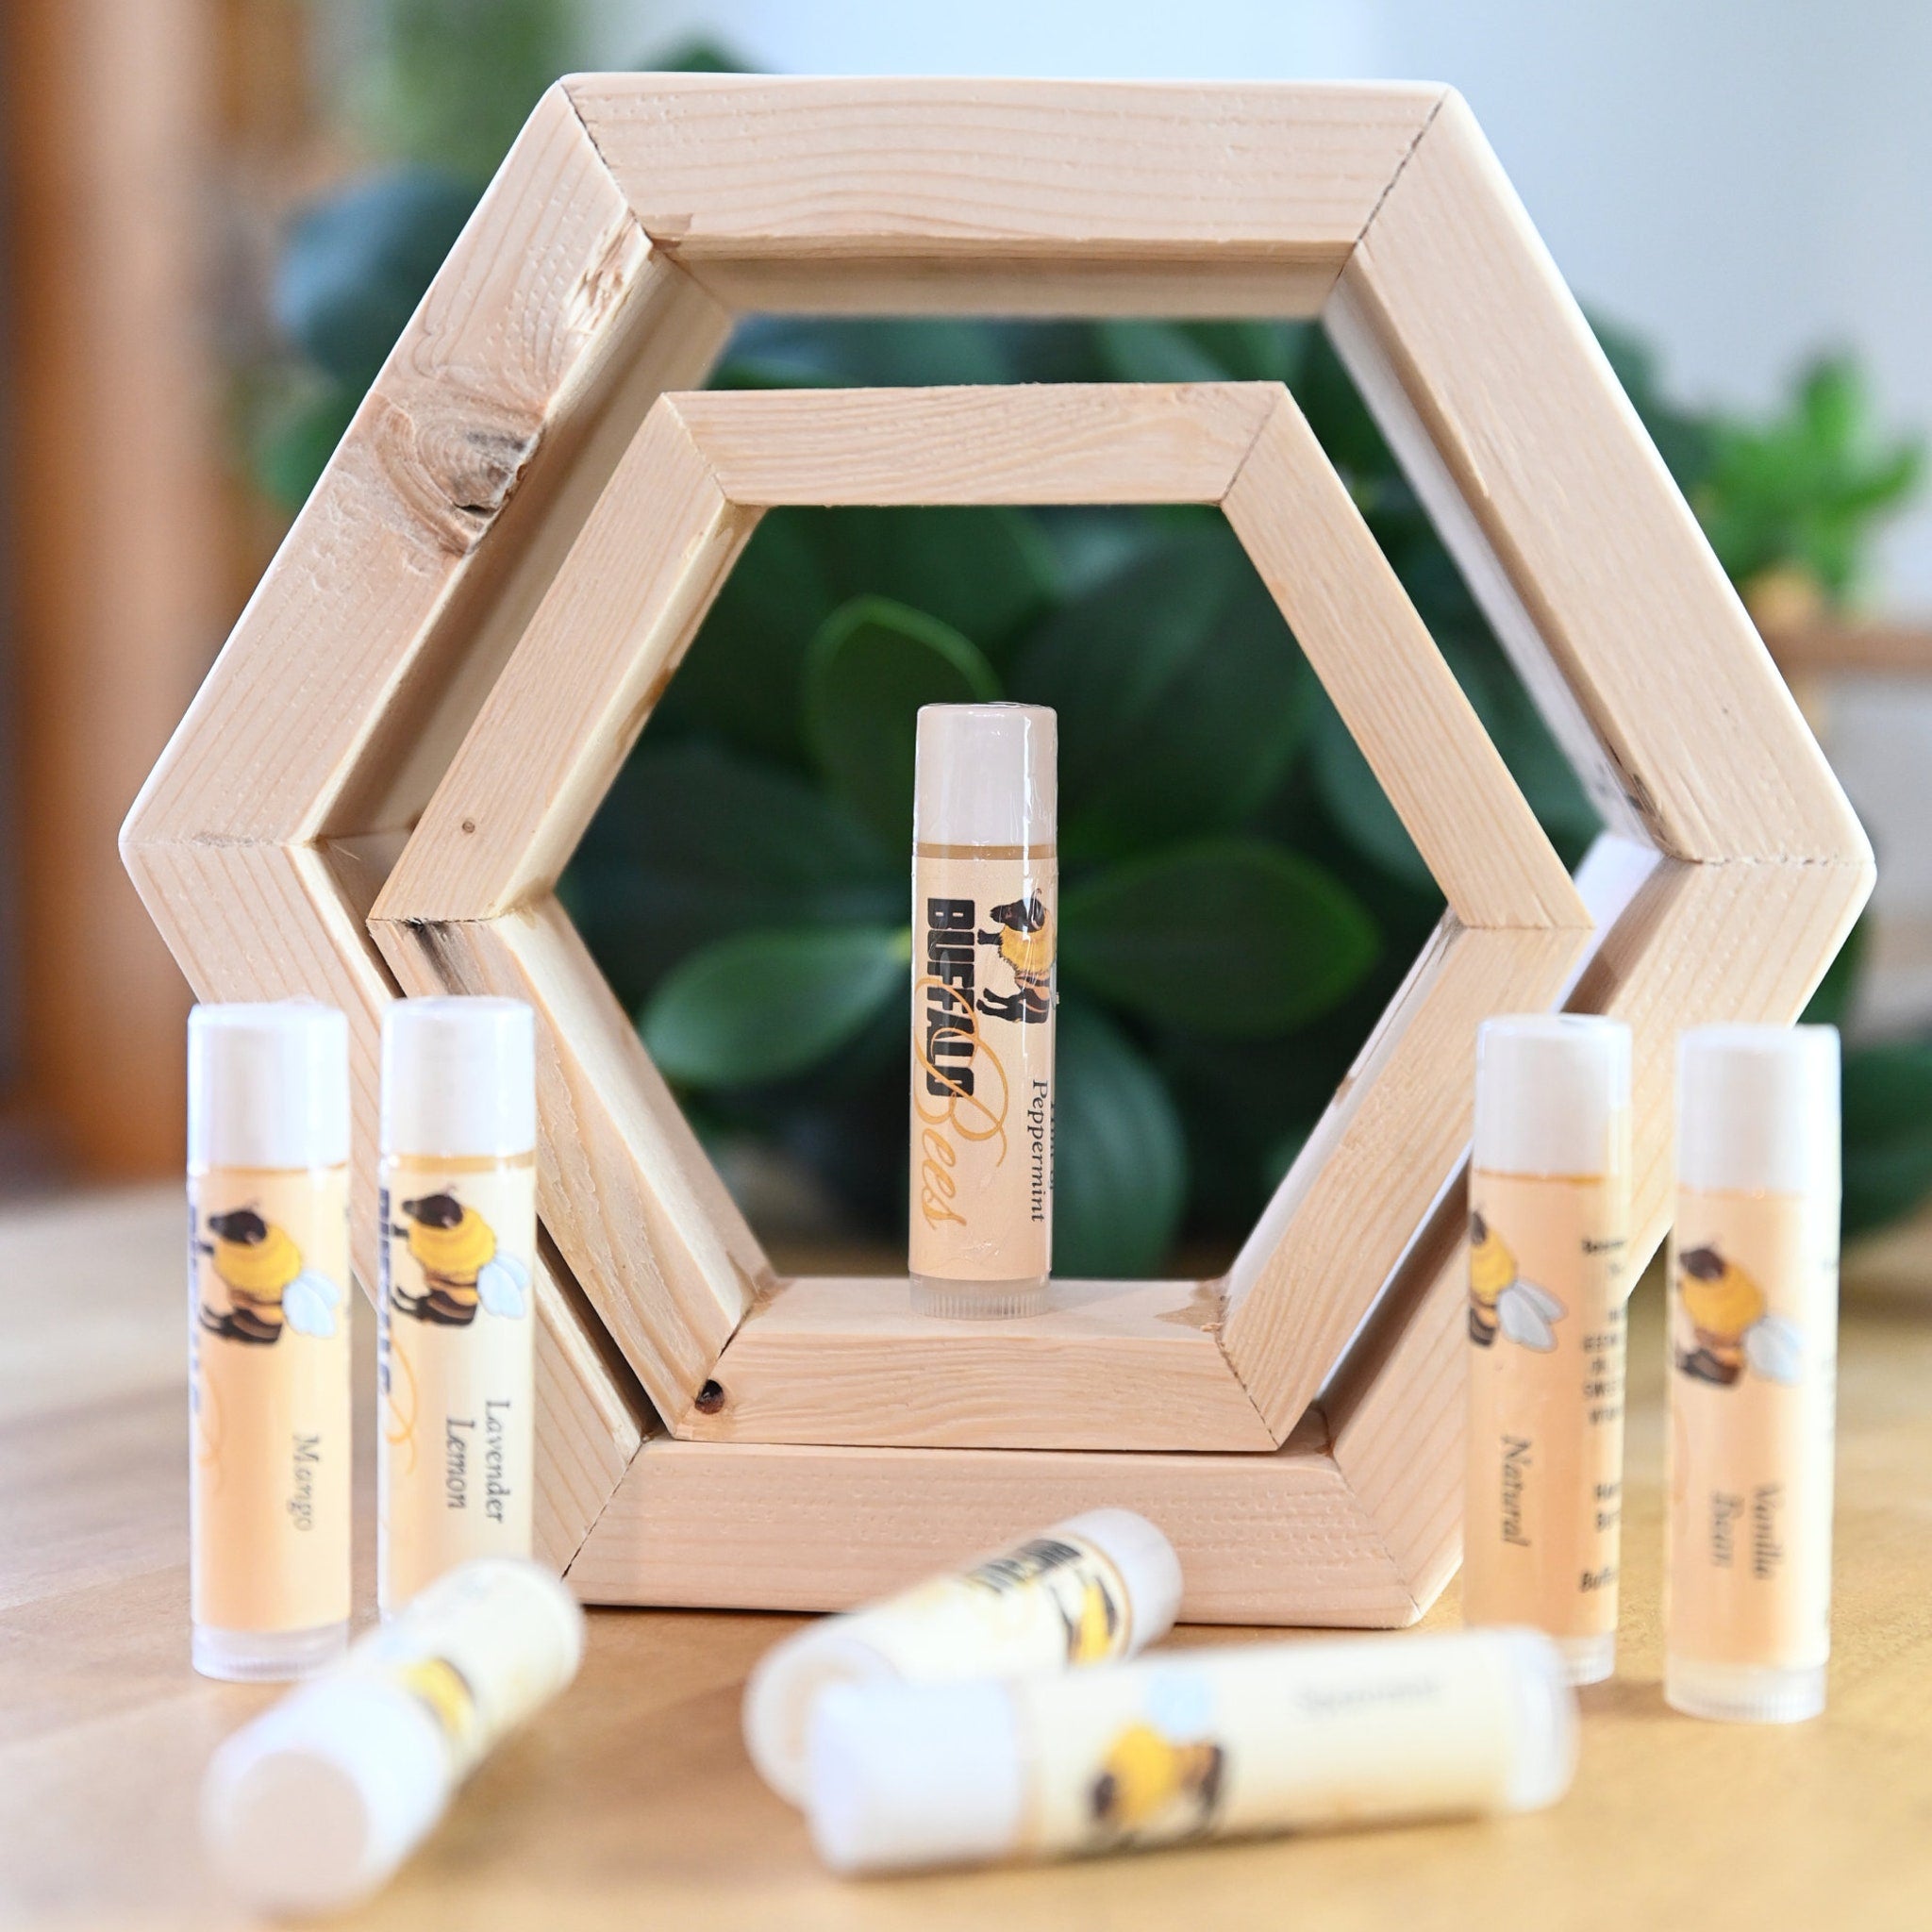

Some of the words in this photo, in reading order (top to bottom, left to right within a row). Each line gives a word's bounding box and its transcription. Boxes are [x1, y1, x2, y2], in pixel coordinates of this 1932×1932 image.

[927, 898, 974, 1097] BUFFALO
[914, 977, 1008, 1230] Bees
[1027, 1079, 1048, 1222] Peppermint
[287, 1434, 320, 1530] Mango
[446, 1418, 475, 1509] Lemon
[486, 1400, 511, 1523] Lavender
[1501, 1435, 1532, 1548] Natural
